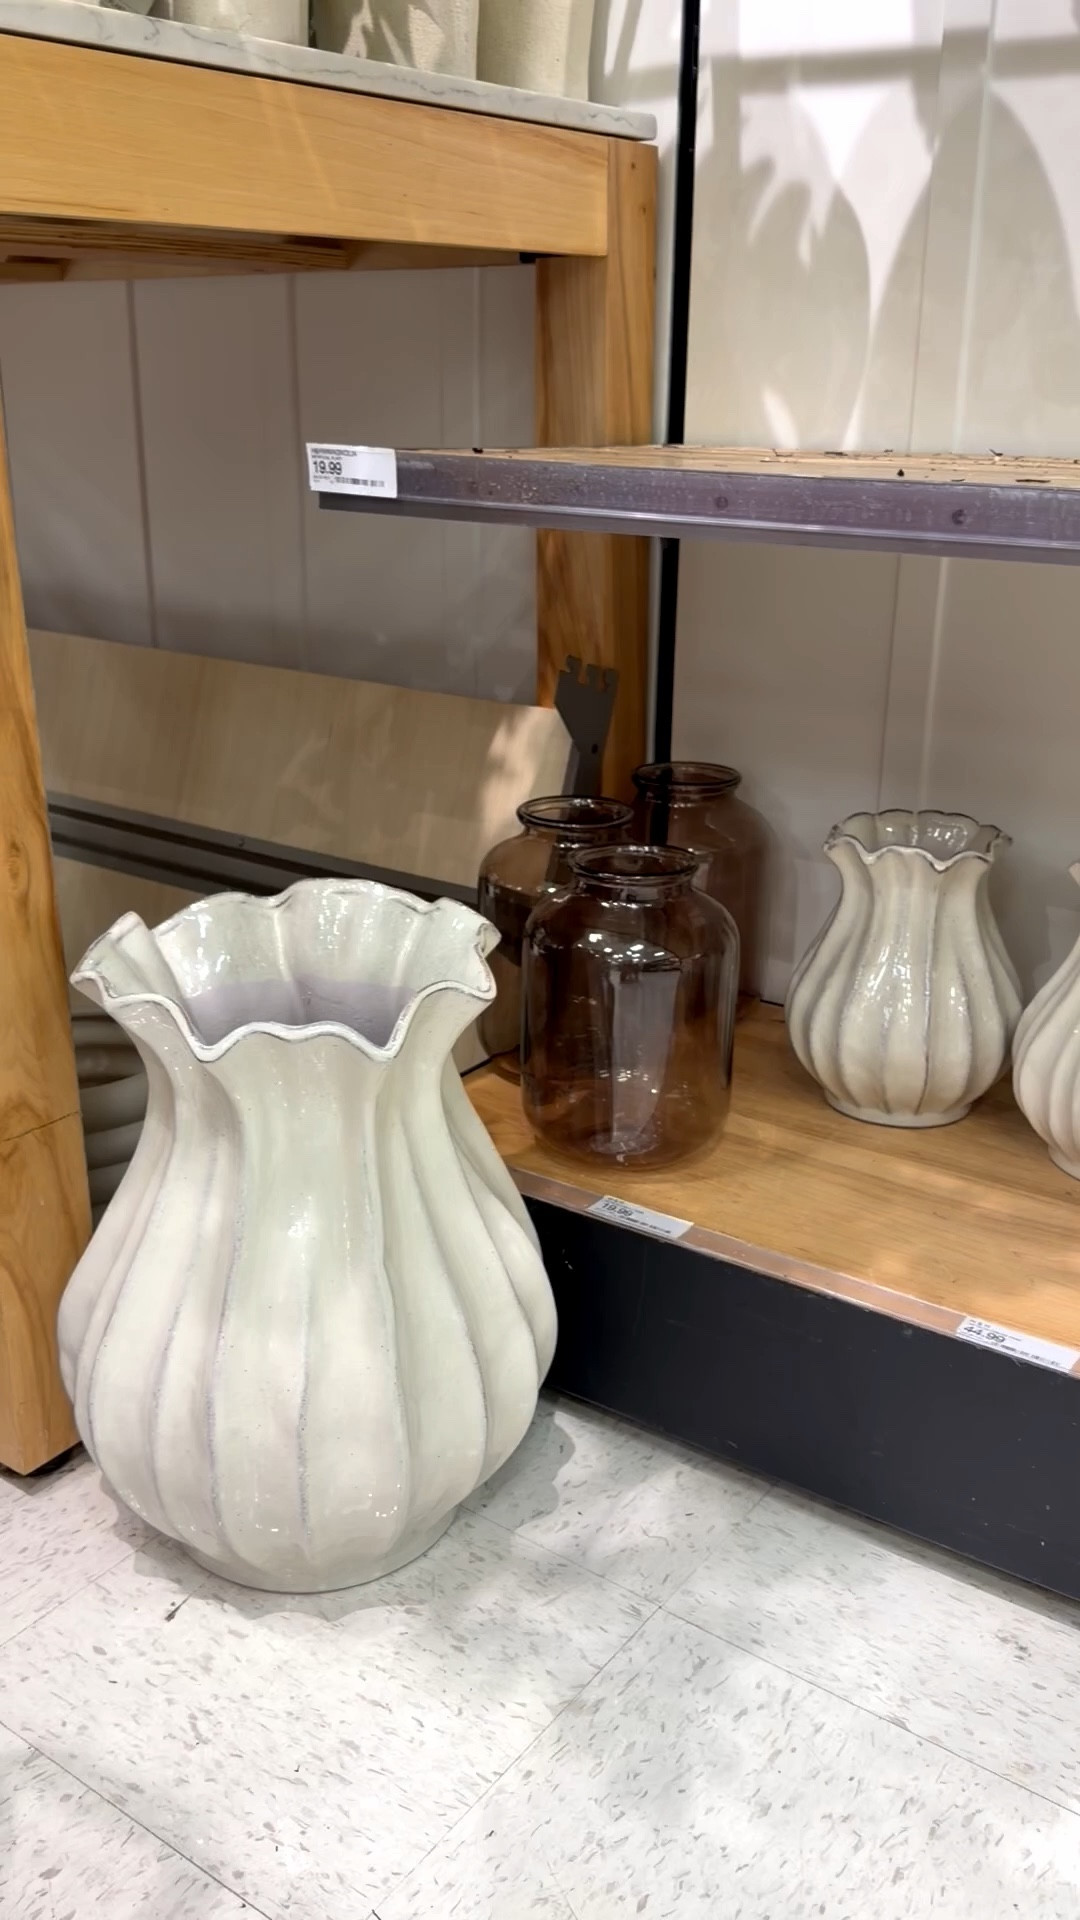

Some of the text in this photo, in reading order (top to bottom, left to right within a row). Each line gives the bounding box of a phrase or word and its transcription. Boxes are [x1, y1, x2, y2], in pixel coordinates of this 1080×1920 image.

[313, 460, 342, 475] 19.99
[602, 1203, 633, 1216] 19.99
[964, 1326, 1005, 1343] 44.99
